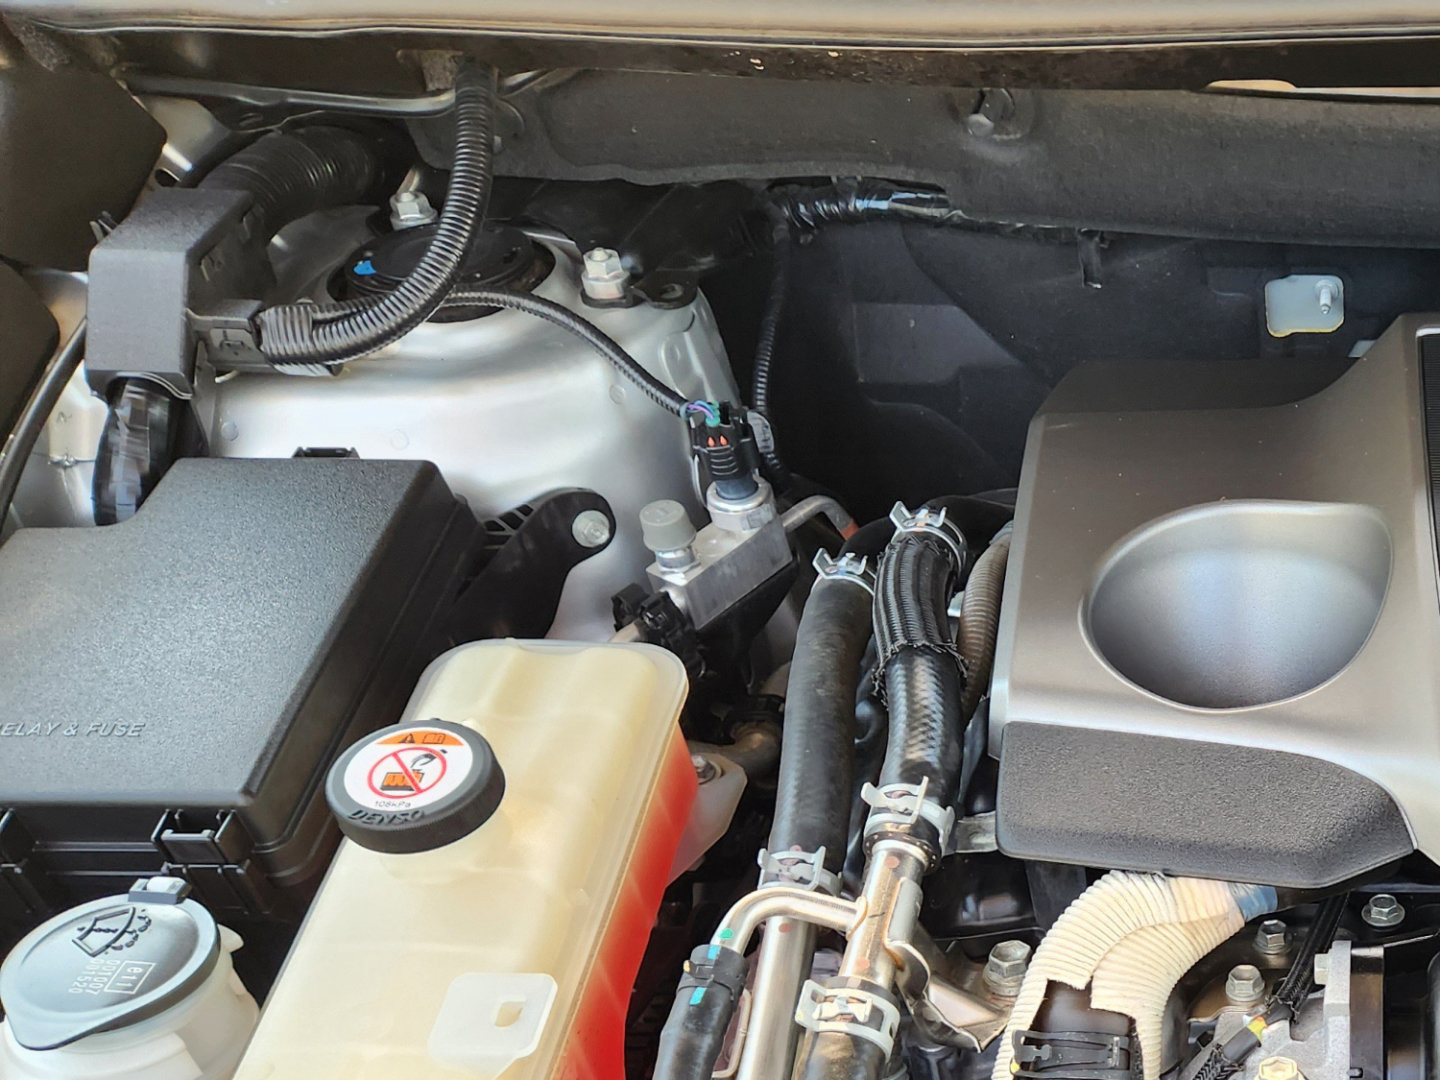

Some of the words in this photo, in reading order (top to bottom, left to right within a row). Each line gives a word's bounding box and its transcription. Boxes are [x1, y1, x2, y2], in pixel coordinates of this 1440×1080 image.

[0, 722, 61, 736] ELAY
[63, 722, 79, 737] &
[86, 720, 146, 737] FUSE
[348, 809, 426, 827] DENSO
